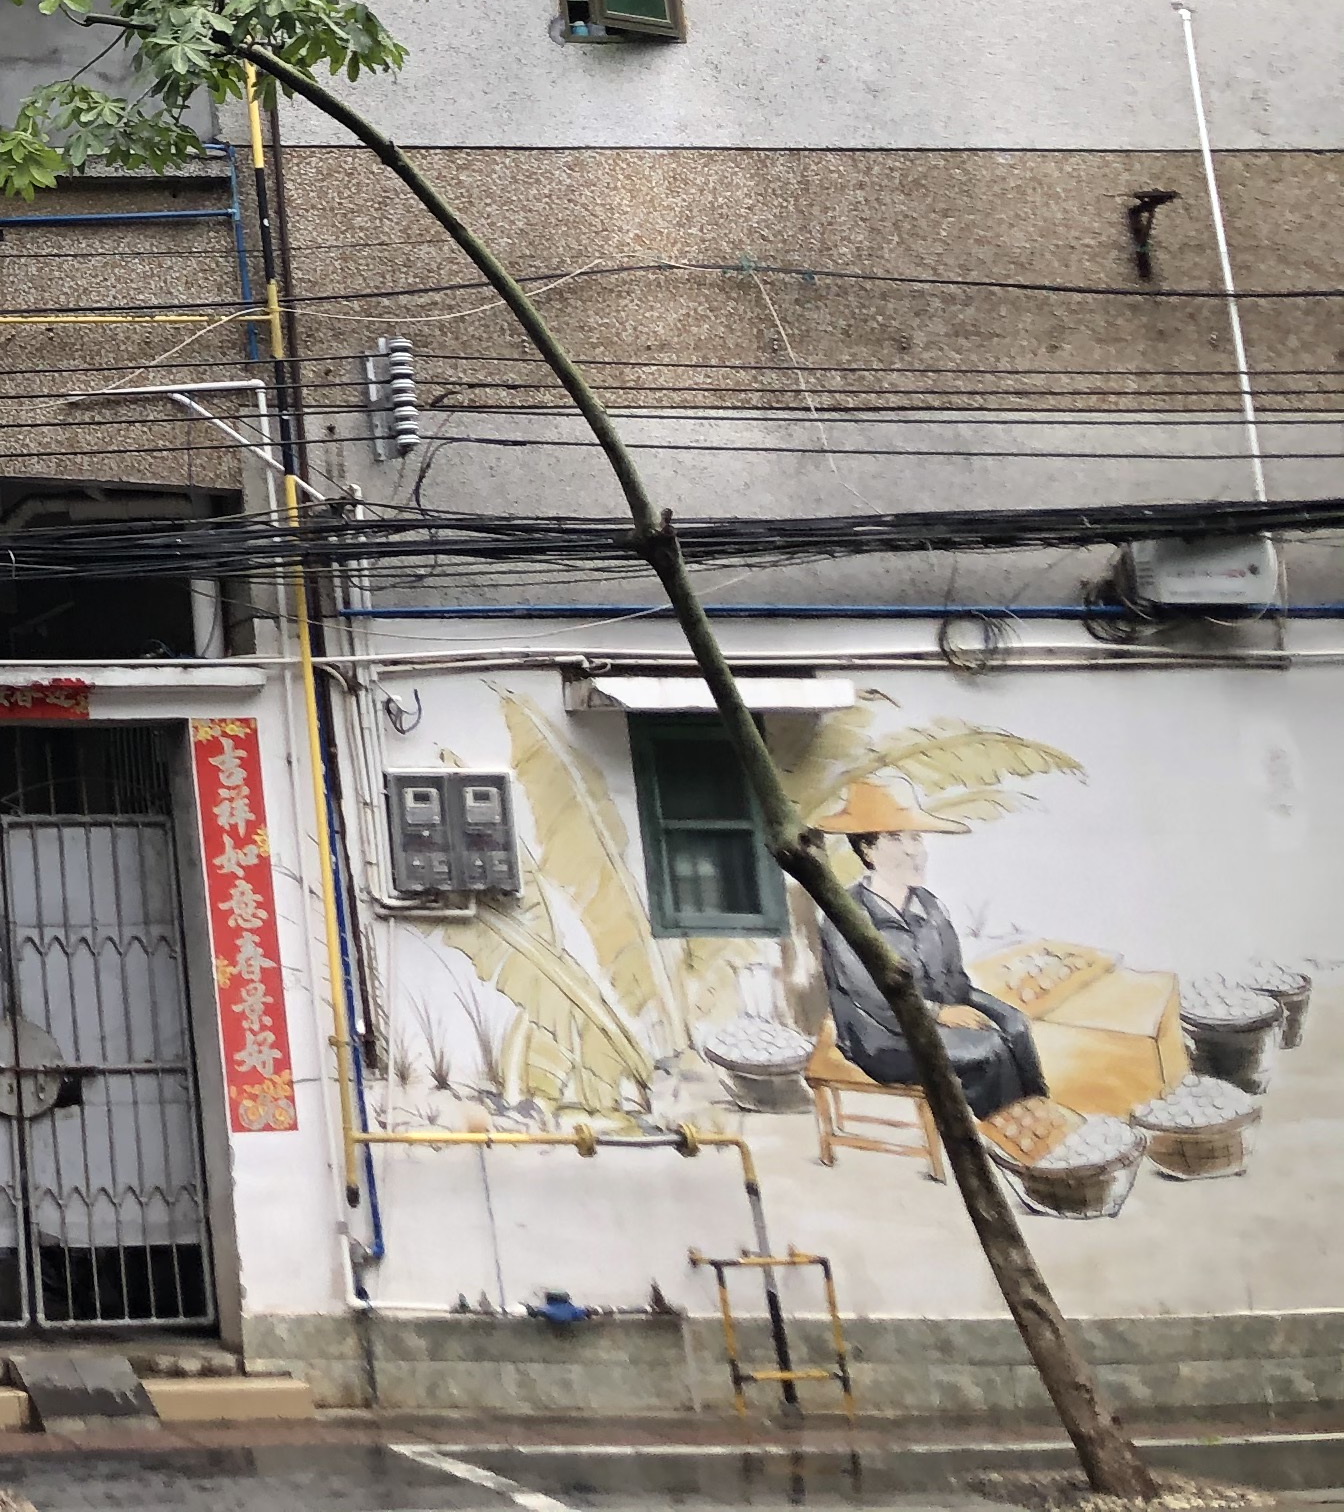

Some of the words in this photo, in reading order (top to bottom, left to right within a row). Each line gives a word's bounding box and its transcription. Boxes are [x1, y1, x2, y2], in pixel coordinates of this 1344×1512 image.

[208, 735, 283, 1078] 吉祥如意春景好
